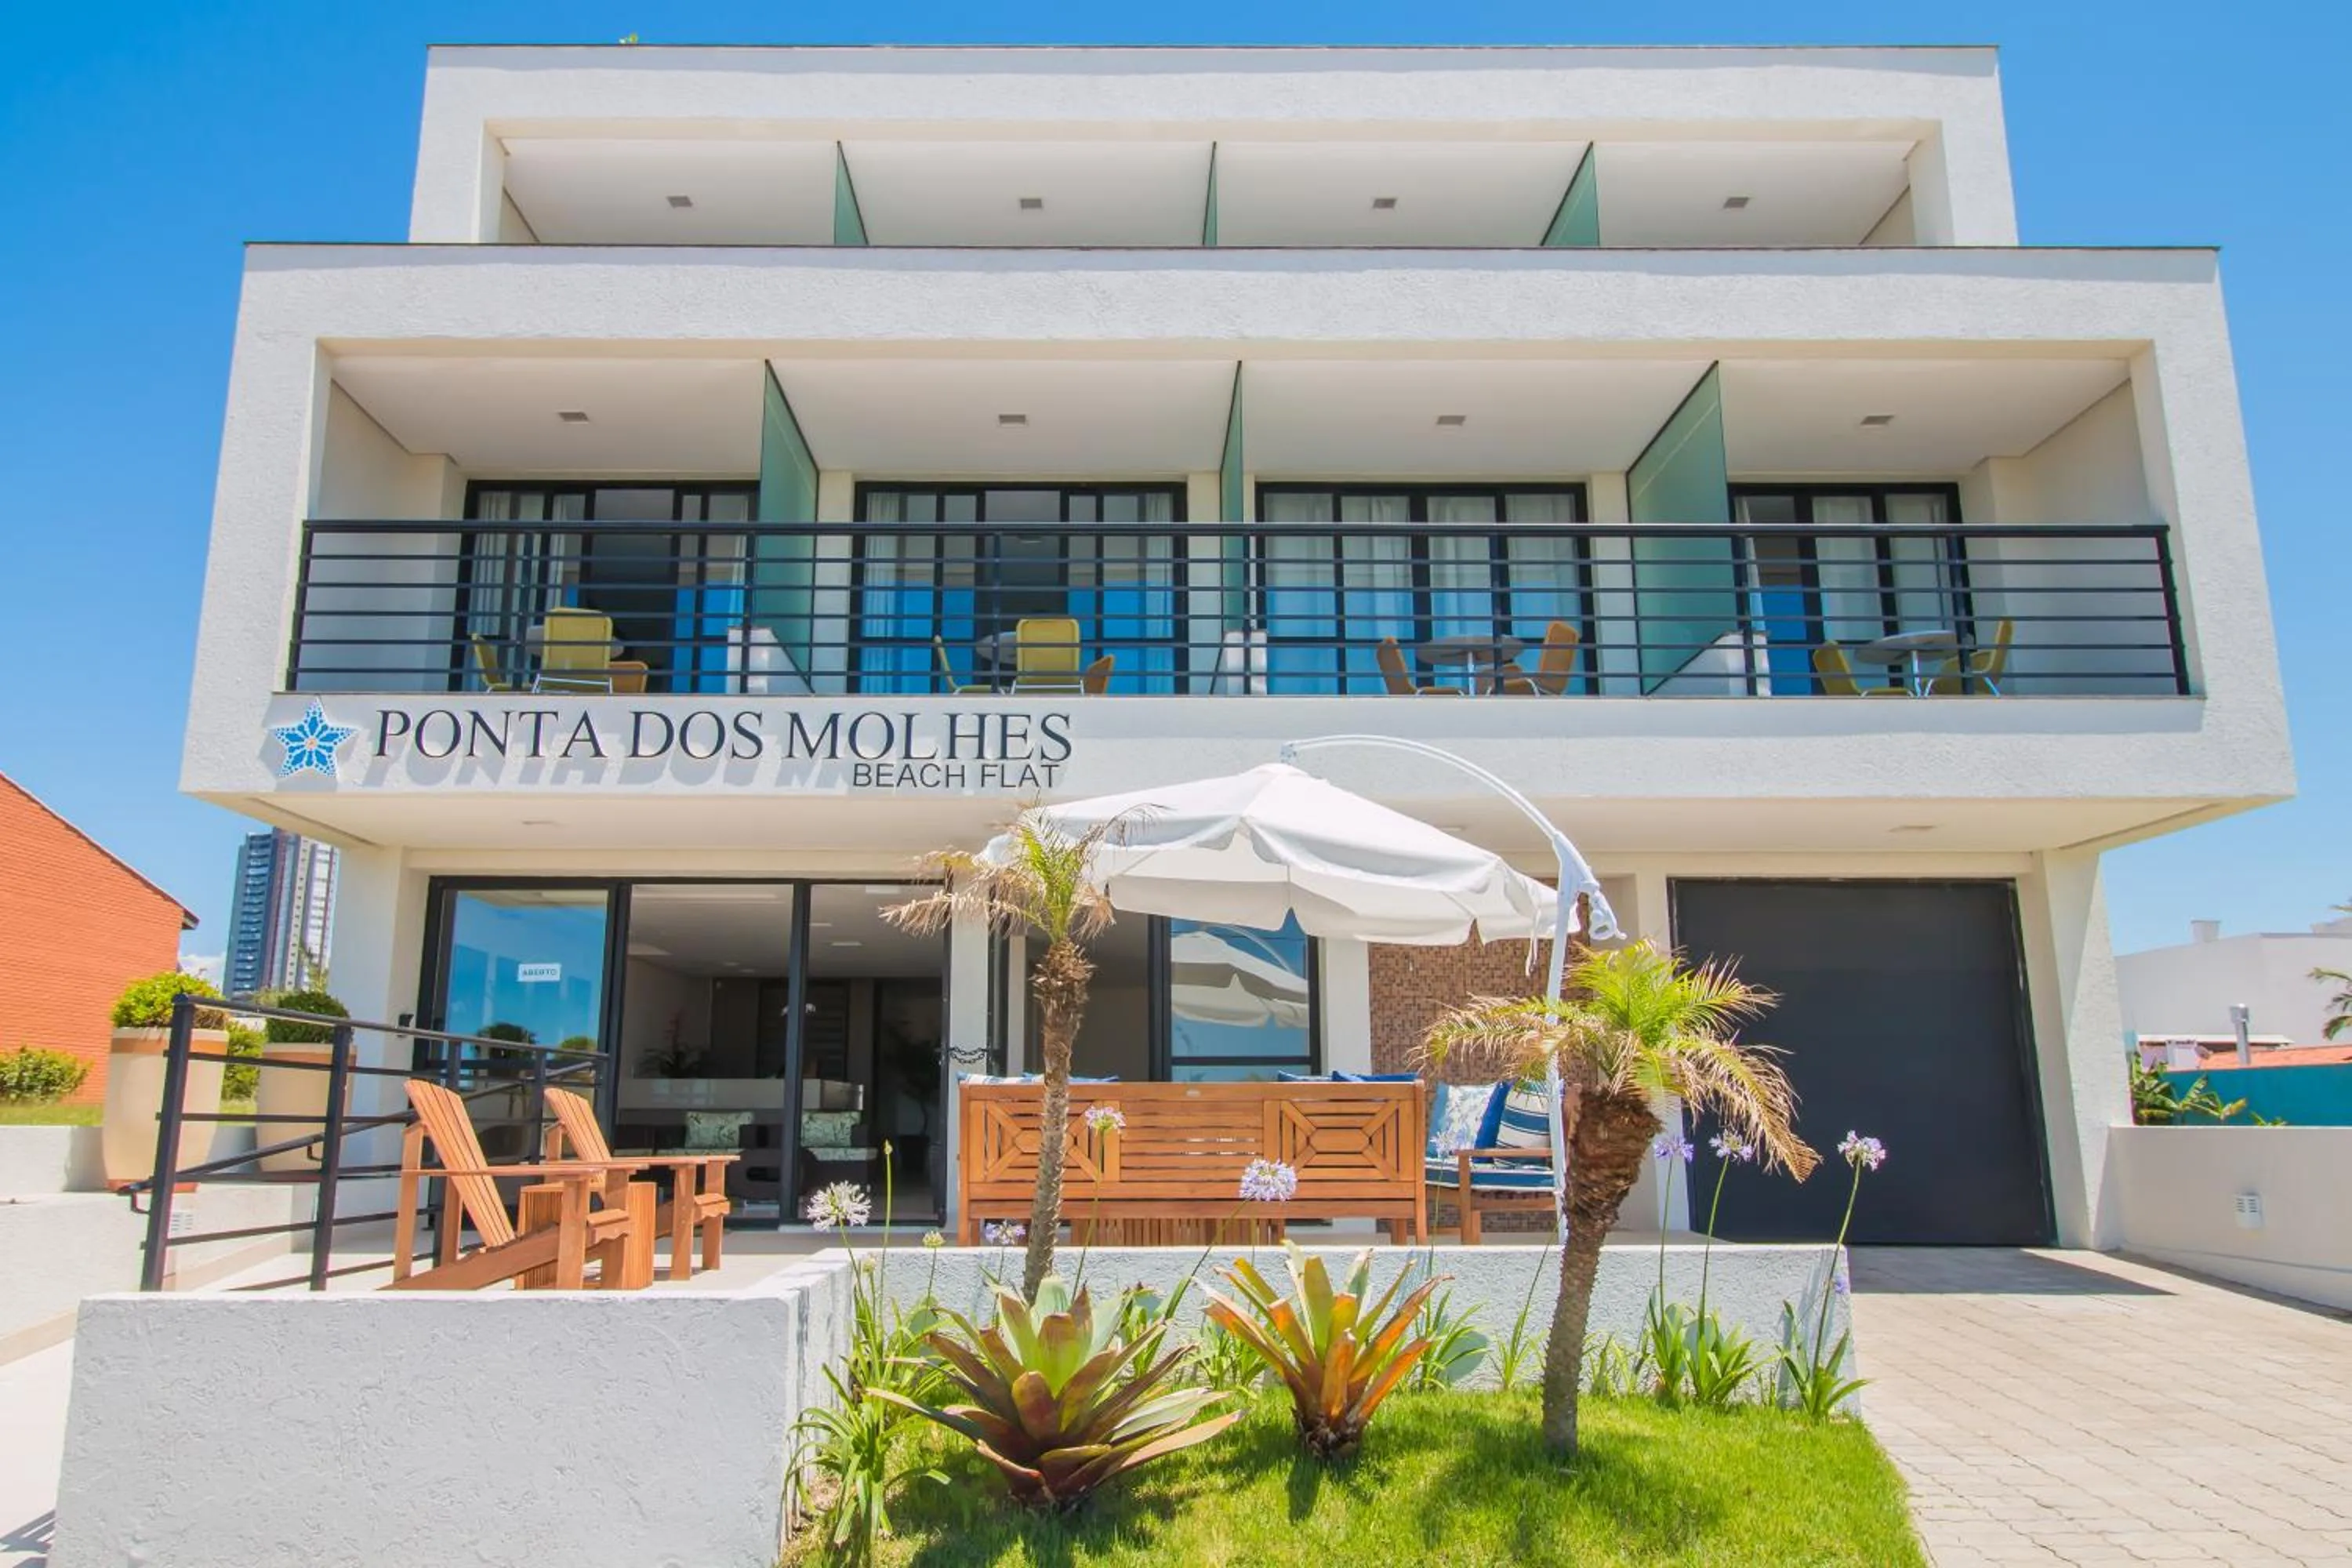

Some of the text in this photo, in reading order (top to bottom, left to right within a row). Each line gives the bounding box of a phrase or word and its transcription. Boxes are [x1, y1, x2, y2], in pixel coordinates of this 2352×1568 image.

[376, 709, 1073, 762] PONTA DOS MOLHES
[852, 762, 1060, 789] BEACH FLAT
